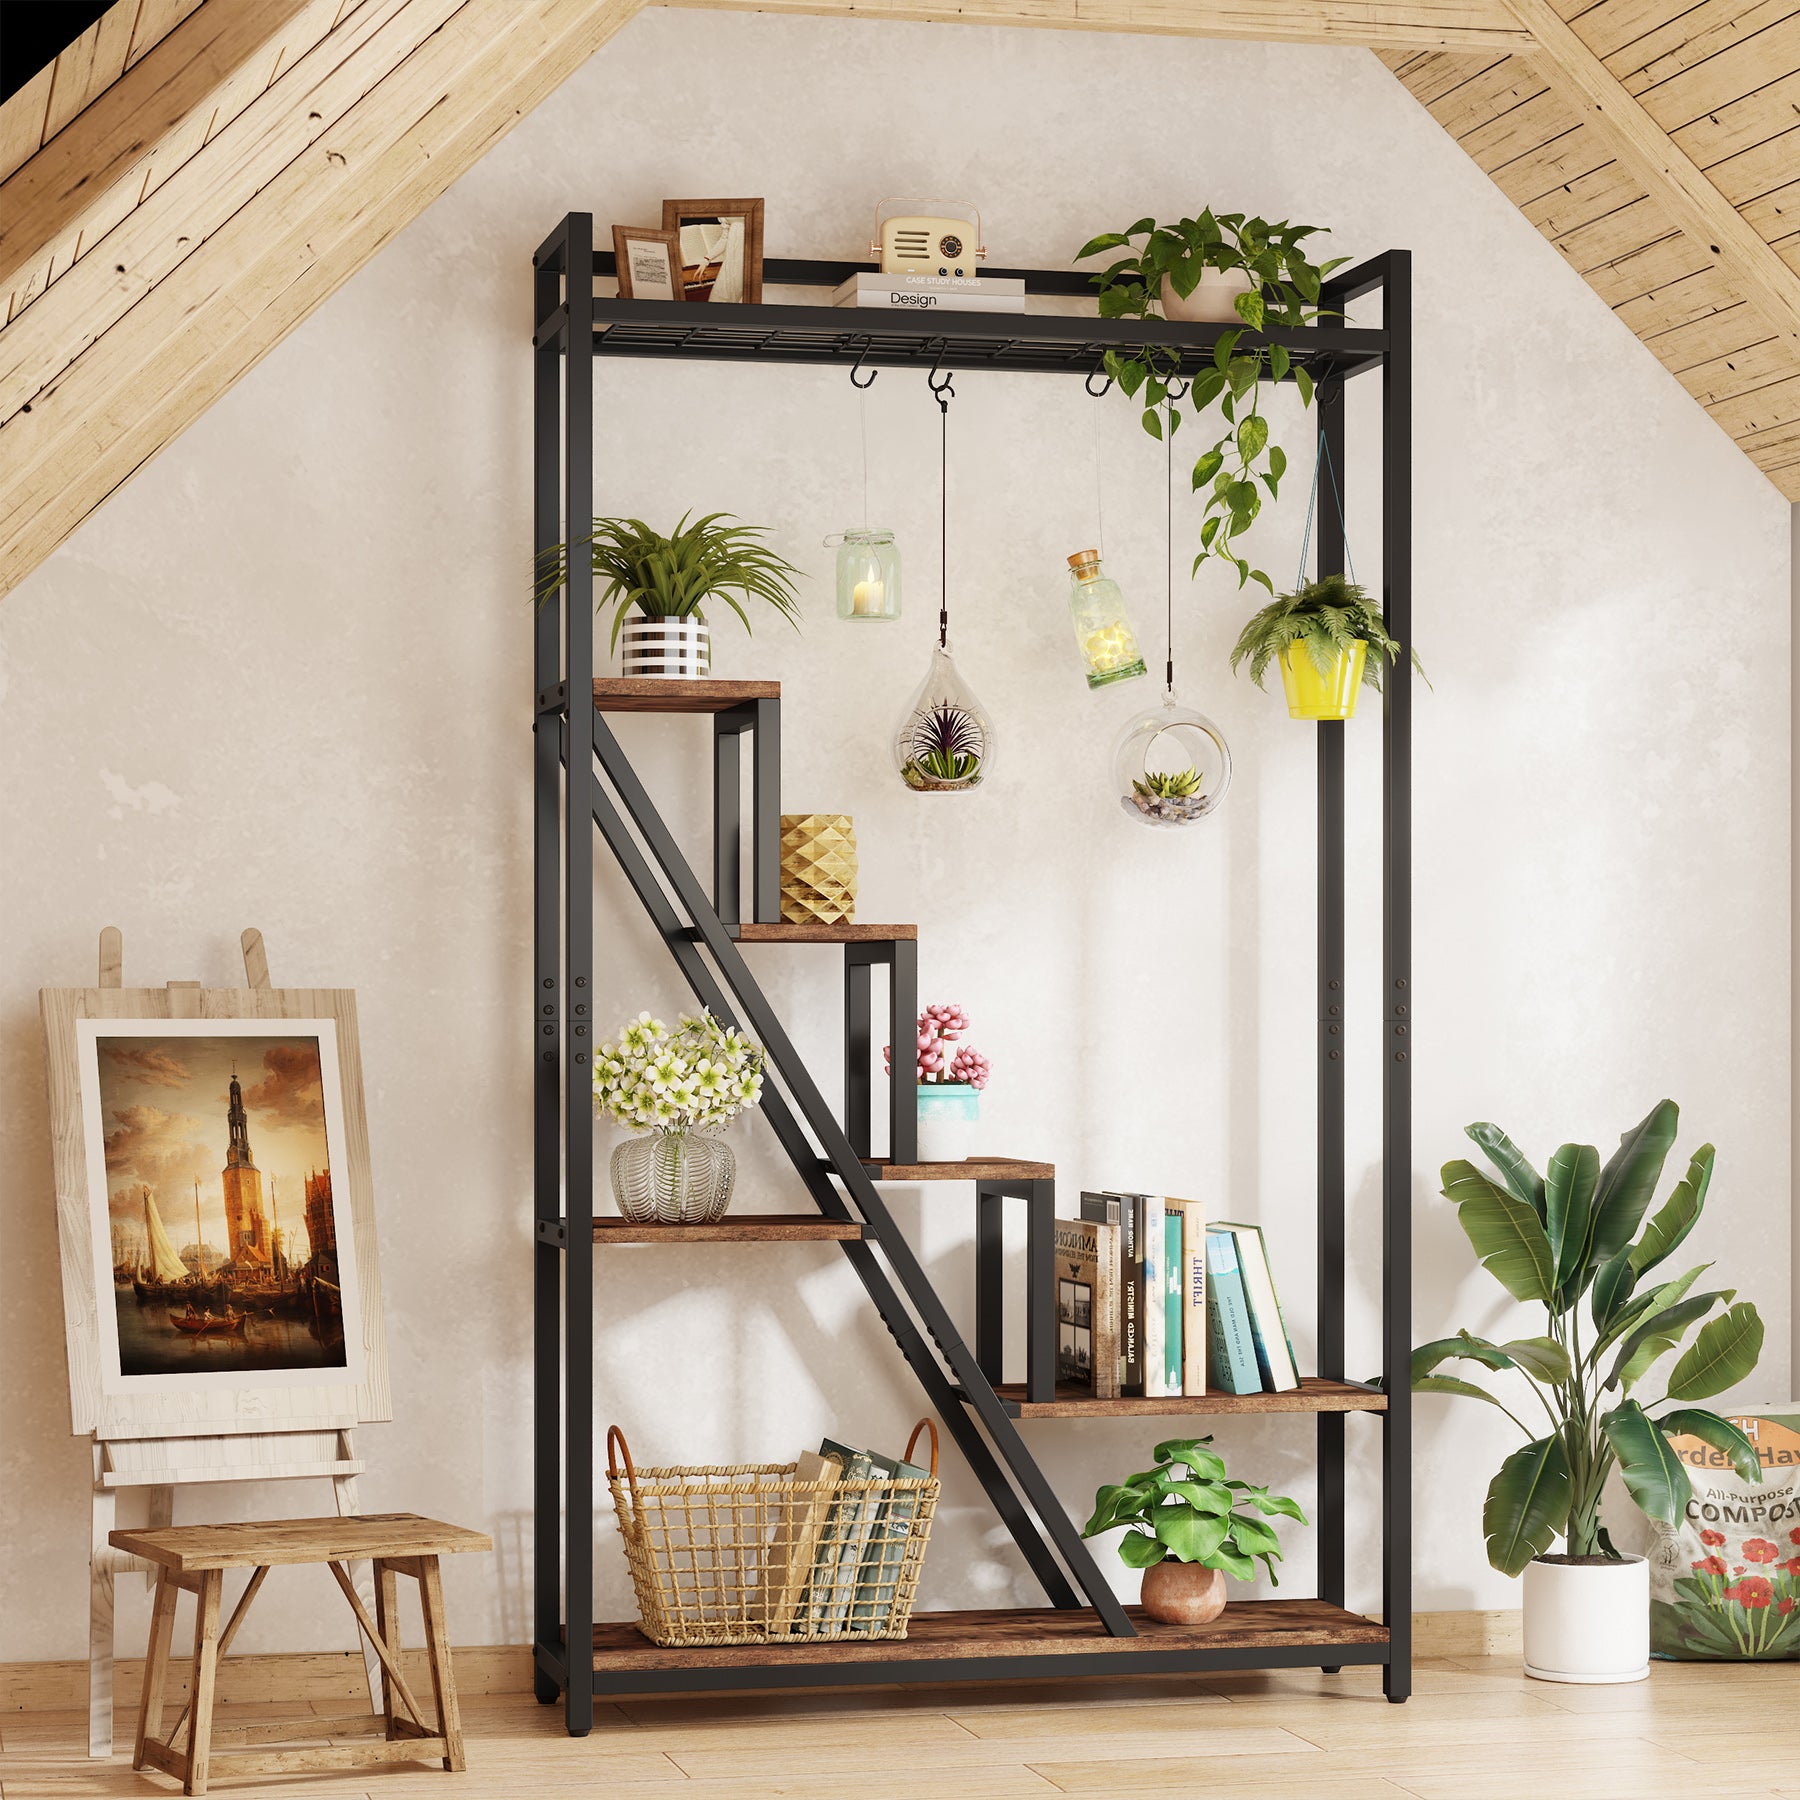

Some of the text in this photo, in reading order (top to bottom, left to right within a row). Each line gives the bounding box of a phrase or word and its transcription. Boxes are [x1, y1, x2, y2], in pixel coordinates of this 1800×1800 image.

[906, 276, 982, 287] CASE STUDY HOUSES
[890, 292, 937, 309] Design
[1706, 1486, 1794, 1505] All-Purpose
